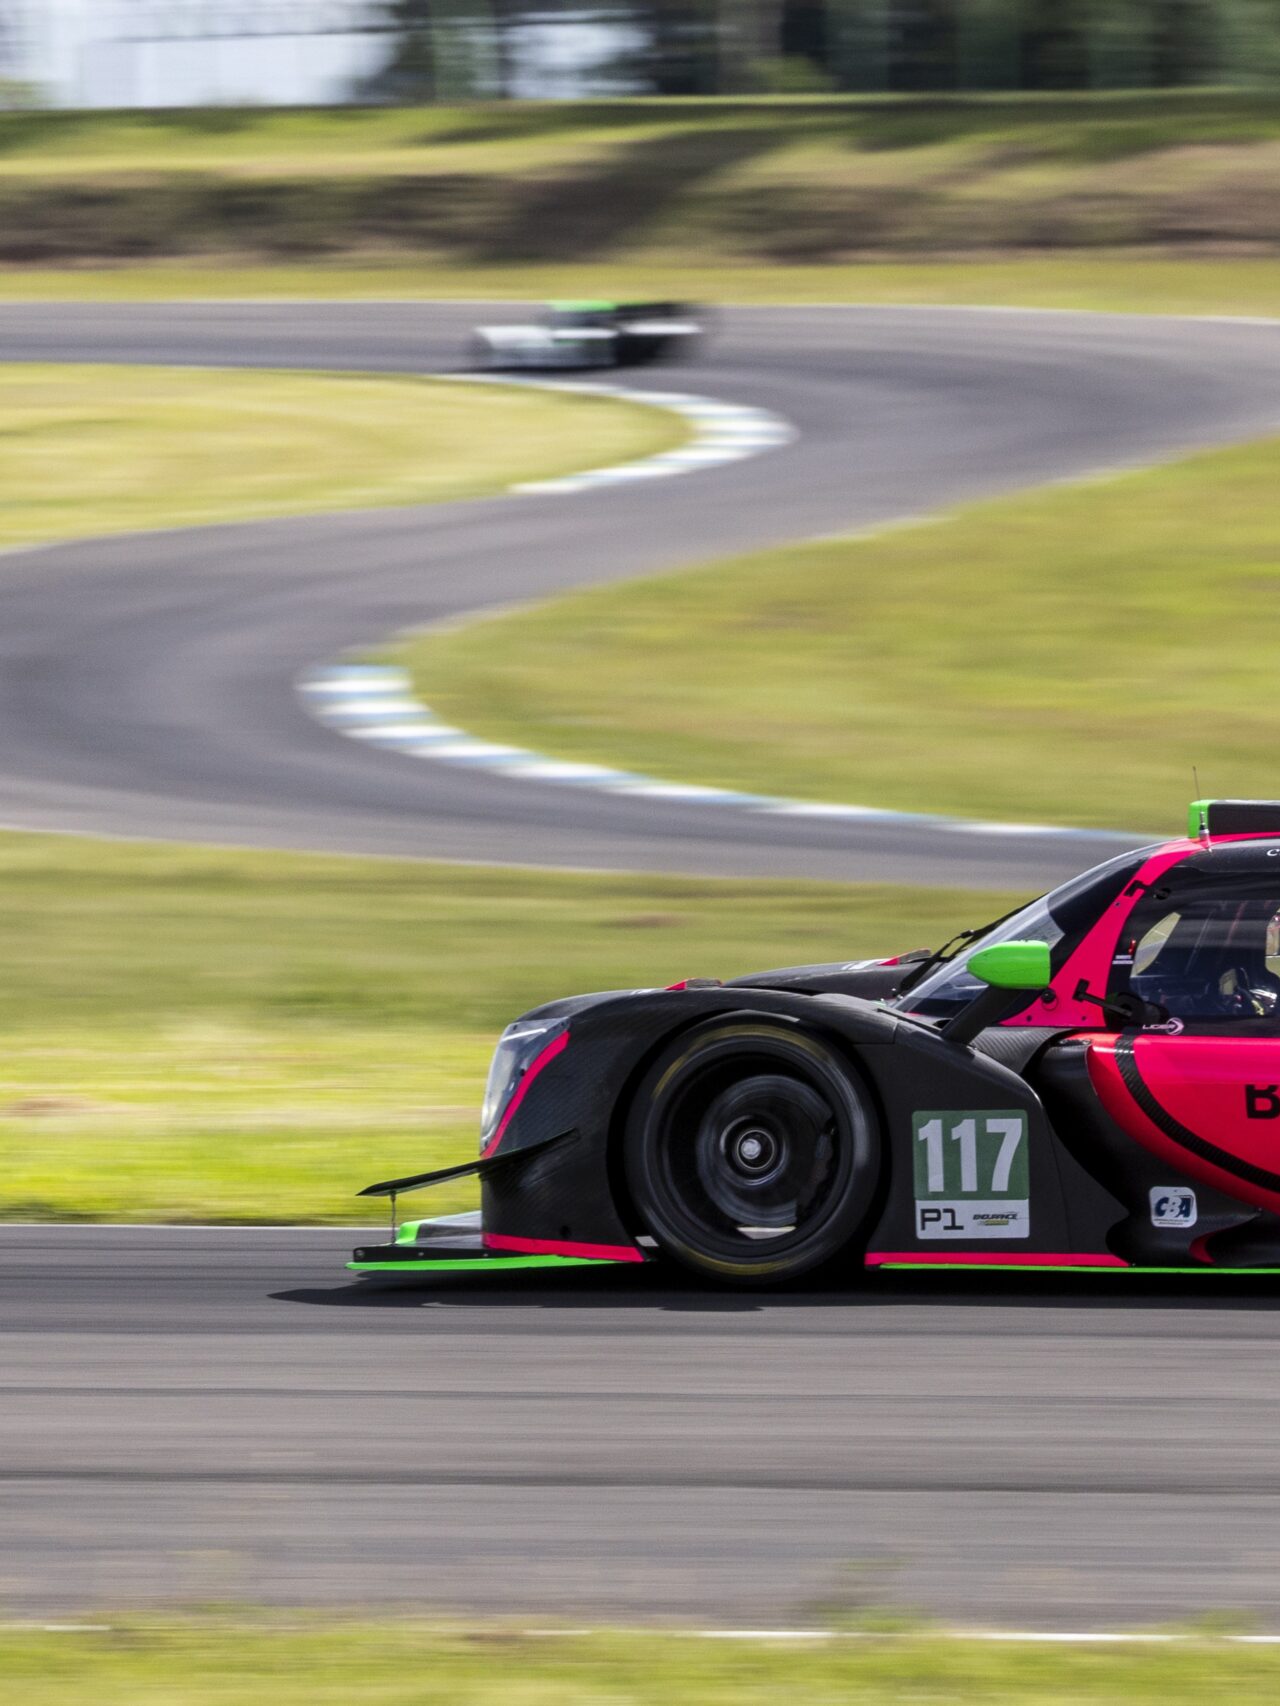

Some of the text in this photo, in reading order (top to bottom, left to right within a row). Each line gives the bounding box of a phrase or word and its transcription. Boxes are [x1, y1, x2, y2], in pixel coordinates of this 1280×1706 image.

[918, 1118, 1022, 1192] 117
[1155, 1196, 1191, 1218] CBA
[920, 1208, 964, 1231] P1
